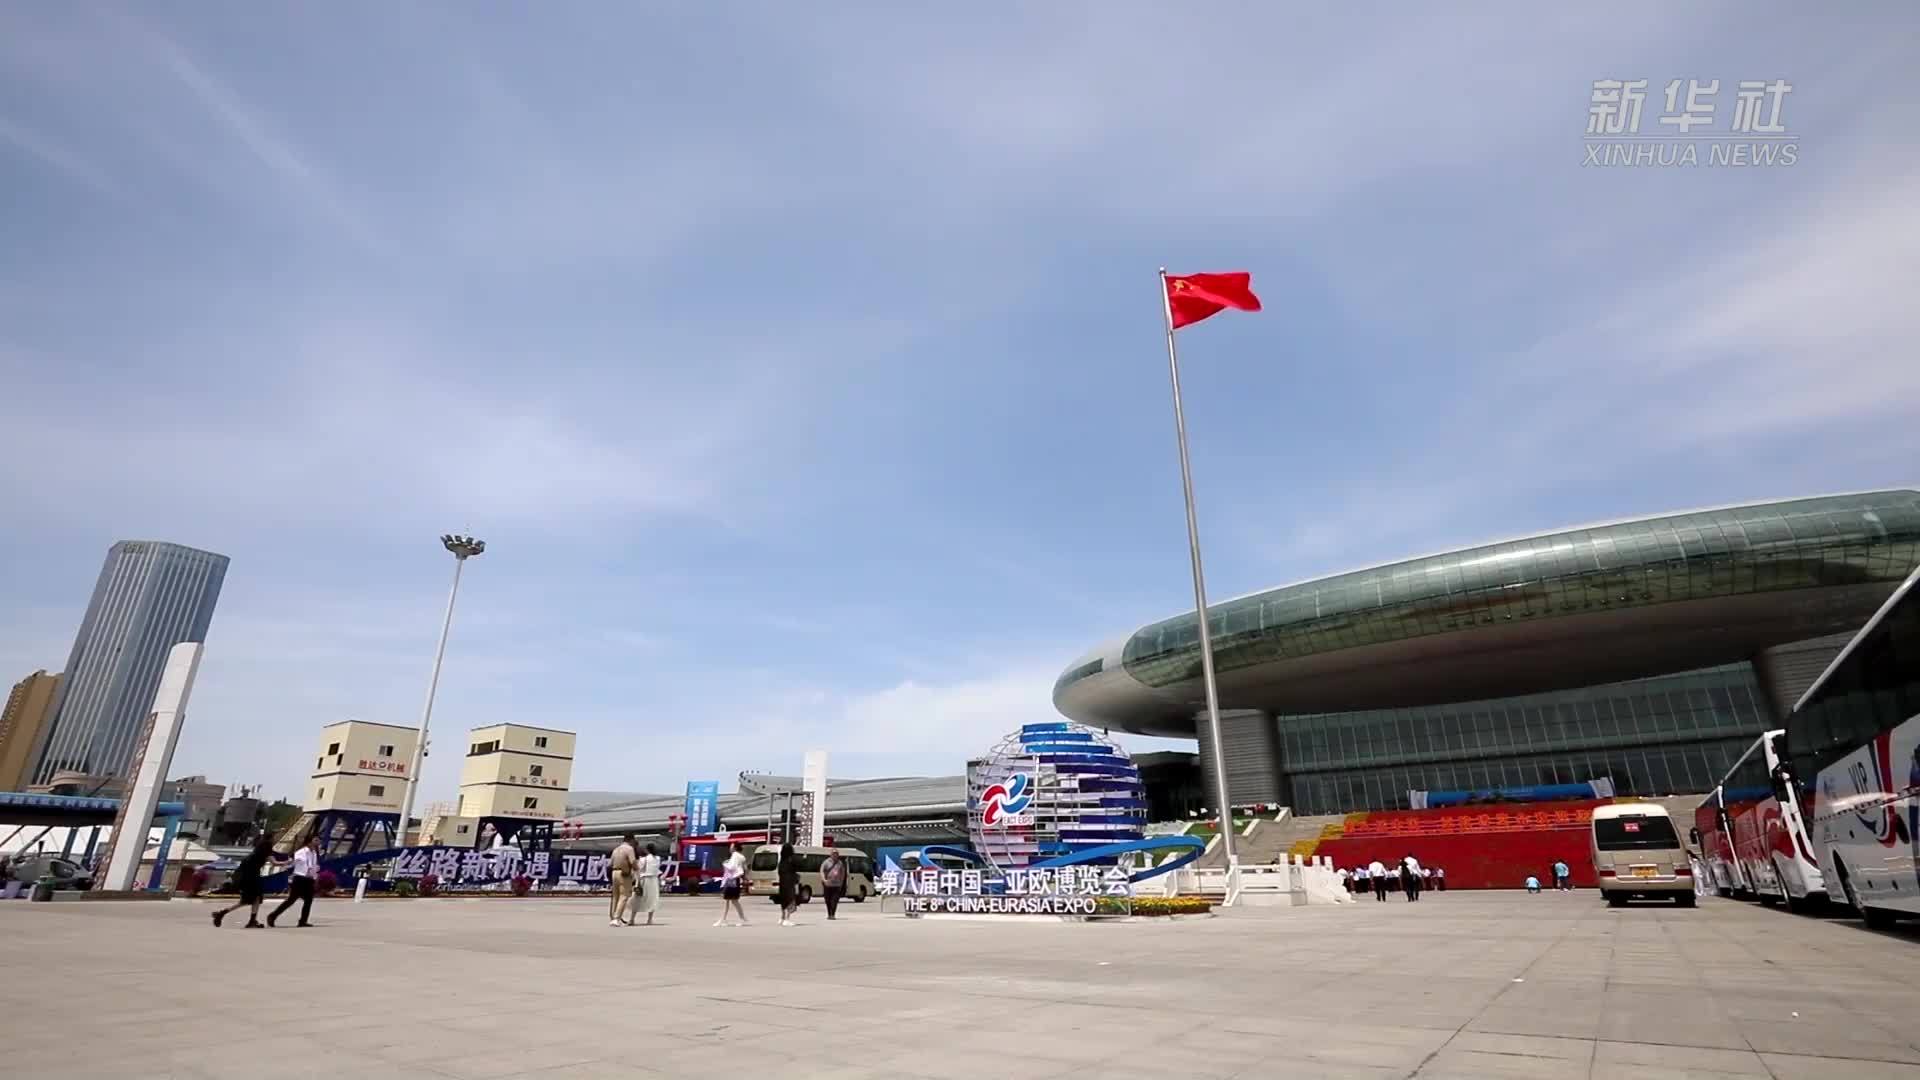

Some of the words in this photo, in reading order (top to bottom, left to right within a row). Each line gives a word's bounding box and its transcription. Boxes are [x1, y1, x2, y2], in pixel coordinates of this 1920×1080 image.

[394, 848, 550, 881] 丝路新机遇
[904, 897, 927, 911] THE
[946, 897, 1052, 913] CHINA-EURASIA
[1054, 897, 1097, 914] EXPO
